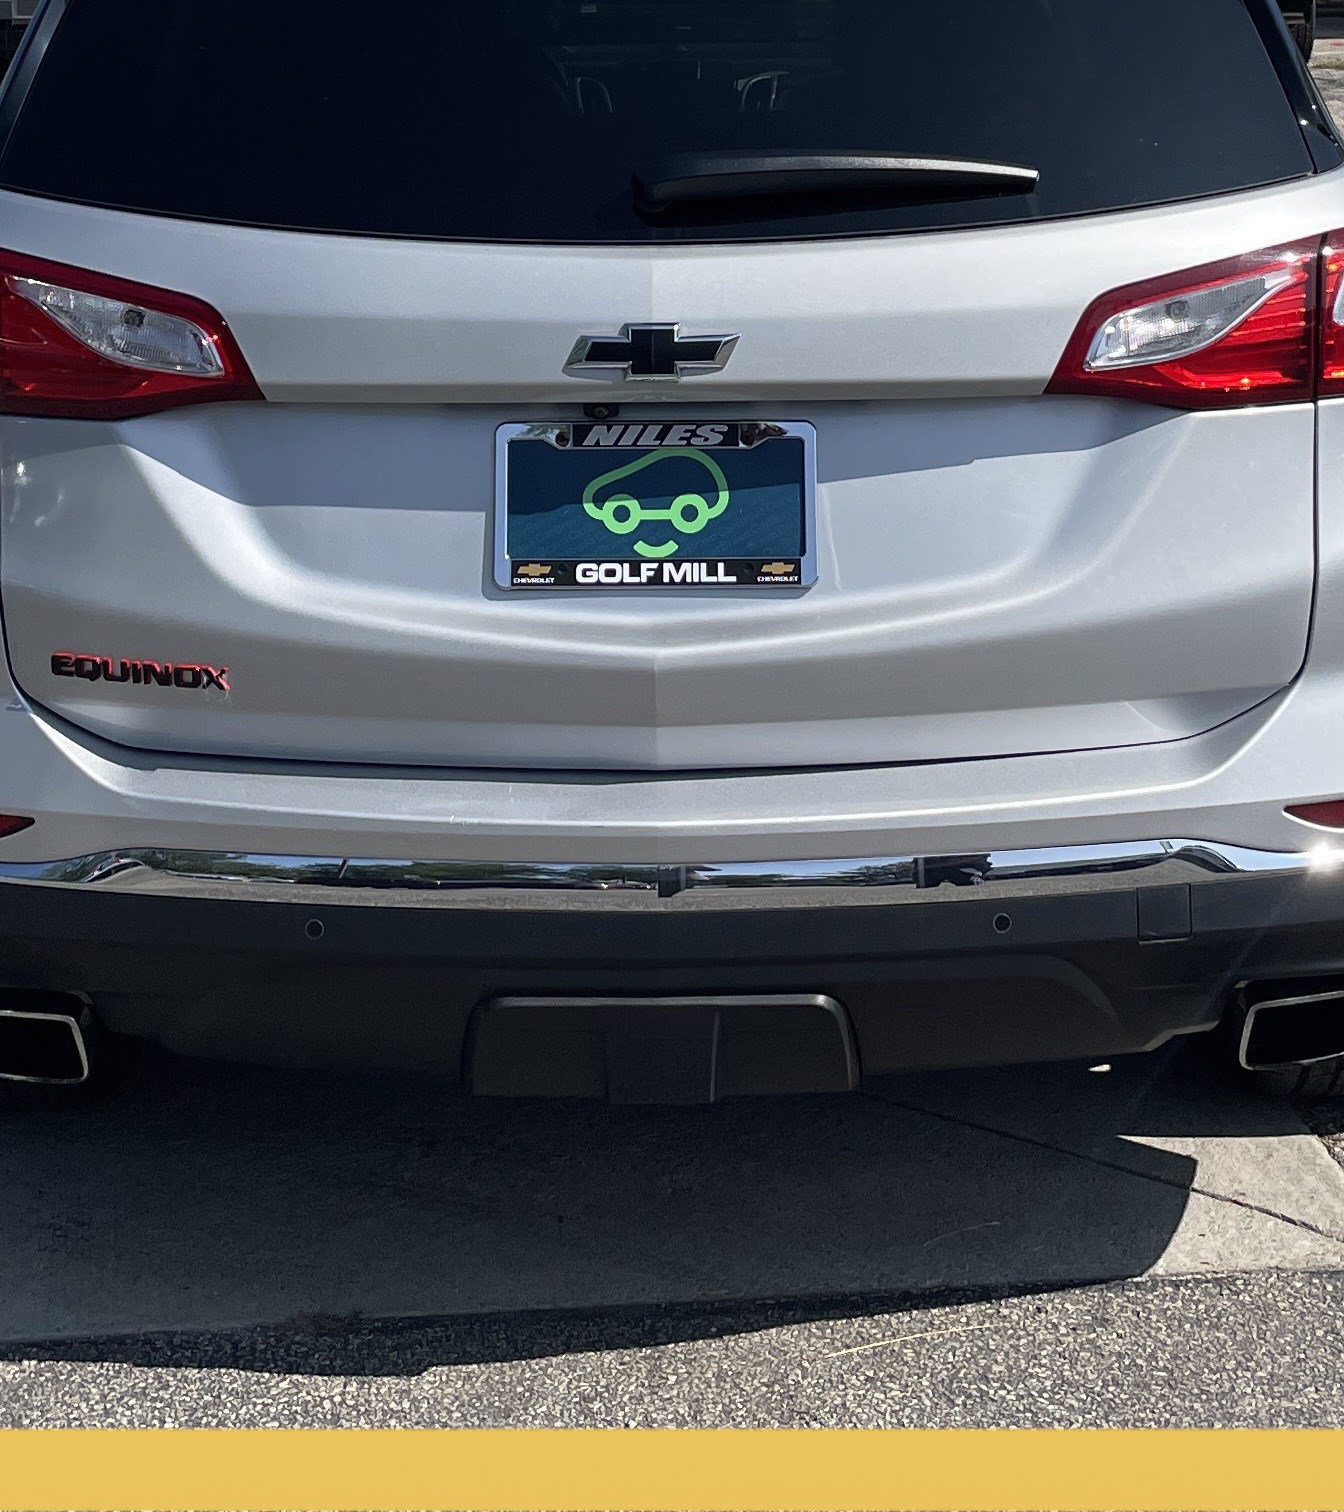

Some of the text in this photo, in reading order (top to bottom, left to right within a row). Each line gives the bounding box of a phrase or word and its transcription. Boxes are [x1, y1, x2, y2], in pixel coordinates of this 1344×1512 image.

[583, 425, 729, 447] NILES
[575, 562, 737, 583] GOLF MILL
[757, 575, 799, 583] CHEVROLET
[51, 651, 231, 691] EQUINOX
